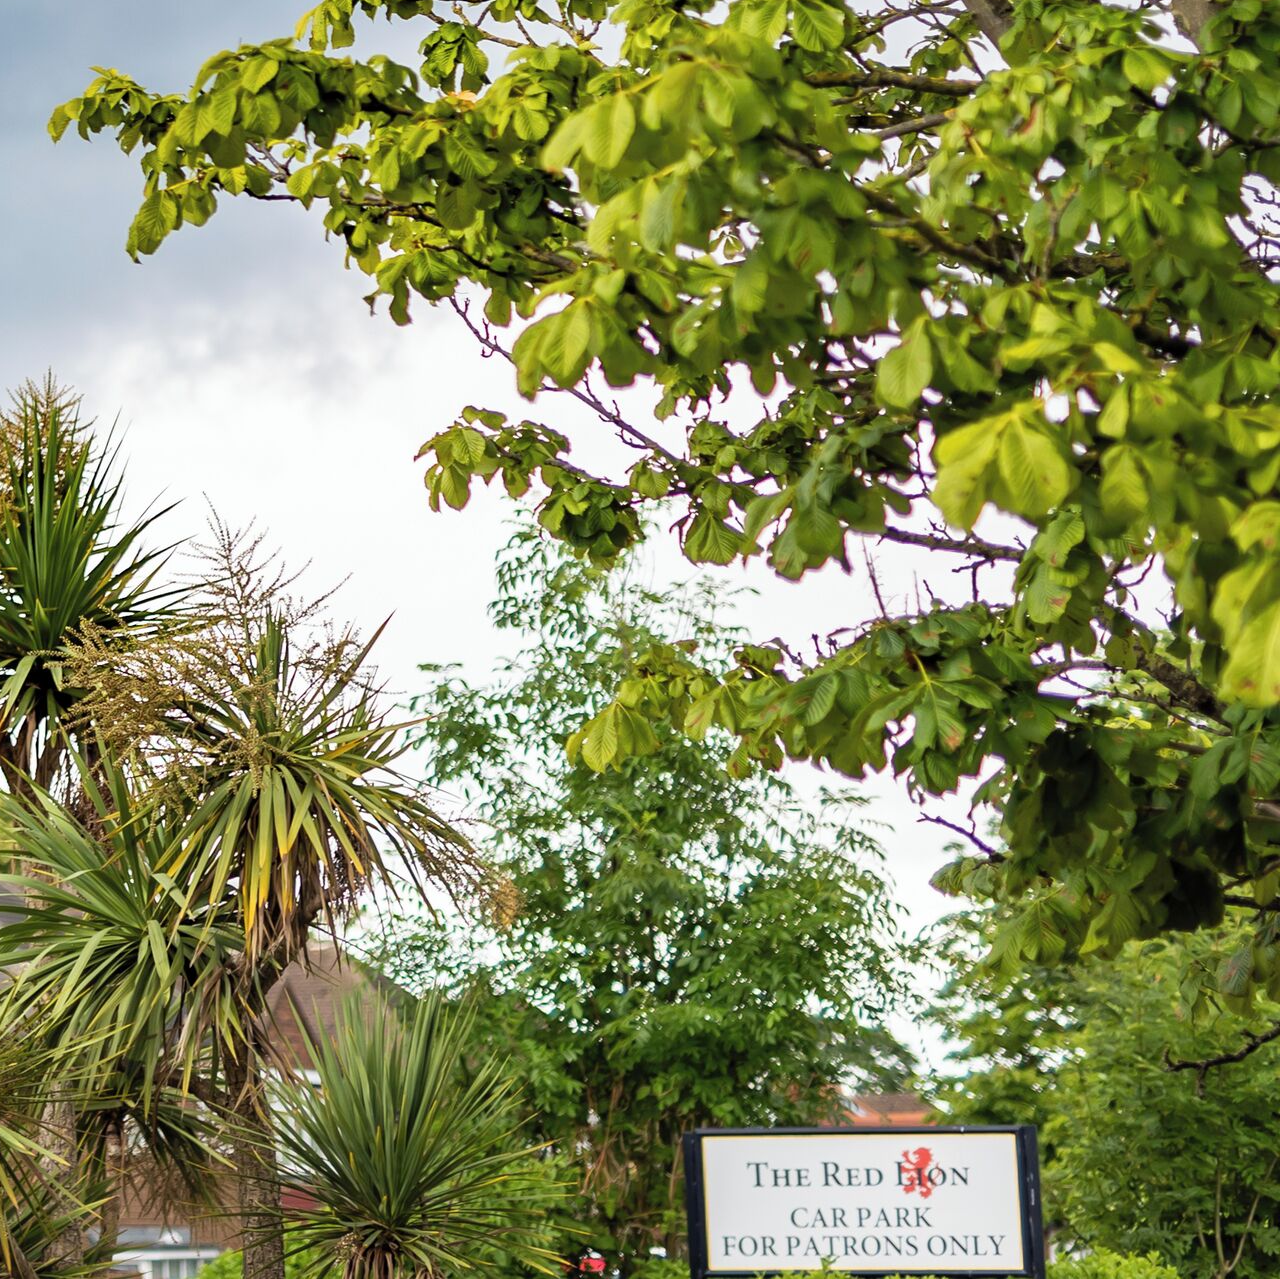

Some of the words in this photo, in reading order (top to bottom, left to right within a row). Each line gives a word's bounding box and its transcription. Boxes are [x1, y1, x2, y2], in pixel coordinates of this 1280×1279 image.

[747, 1161, 812, 1188] THE
[821, 1161, 883, 1188] RED
[790, 1207, 847, 1229] CAR
[856, 1207, 932, 1228] PARK
[723, 1236, 779, 1257] FOR
[786, 1235, 920, 1257] PATRONS
[926, 1234, 1006, 1257] ONLY
